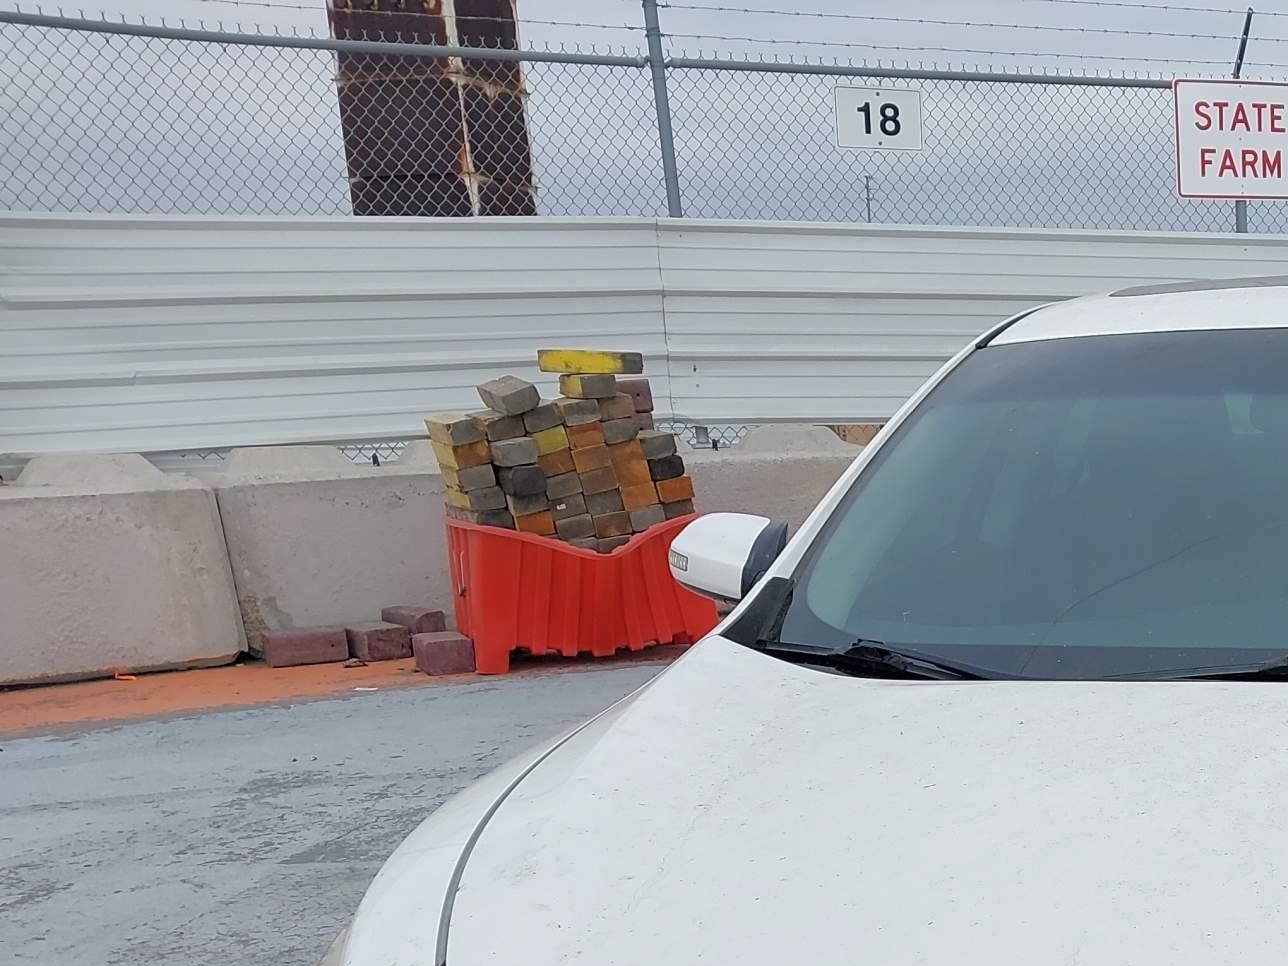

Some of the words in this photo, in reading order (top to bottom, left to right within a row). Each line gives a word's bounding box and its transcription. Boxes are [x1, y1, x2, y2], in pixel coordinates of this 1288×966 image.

[856, 102, 901, 136] 18
[1194, 101, 1286, 132] STATE
[1200, 148, 1283, 178] FARM
